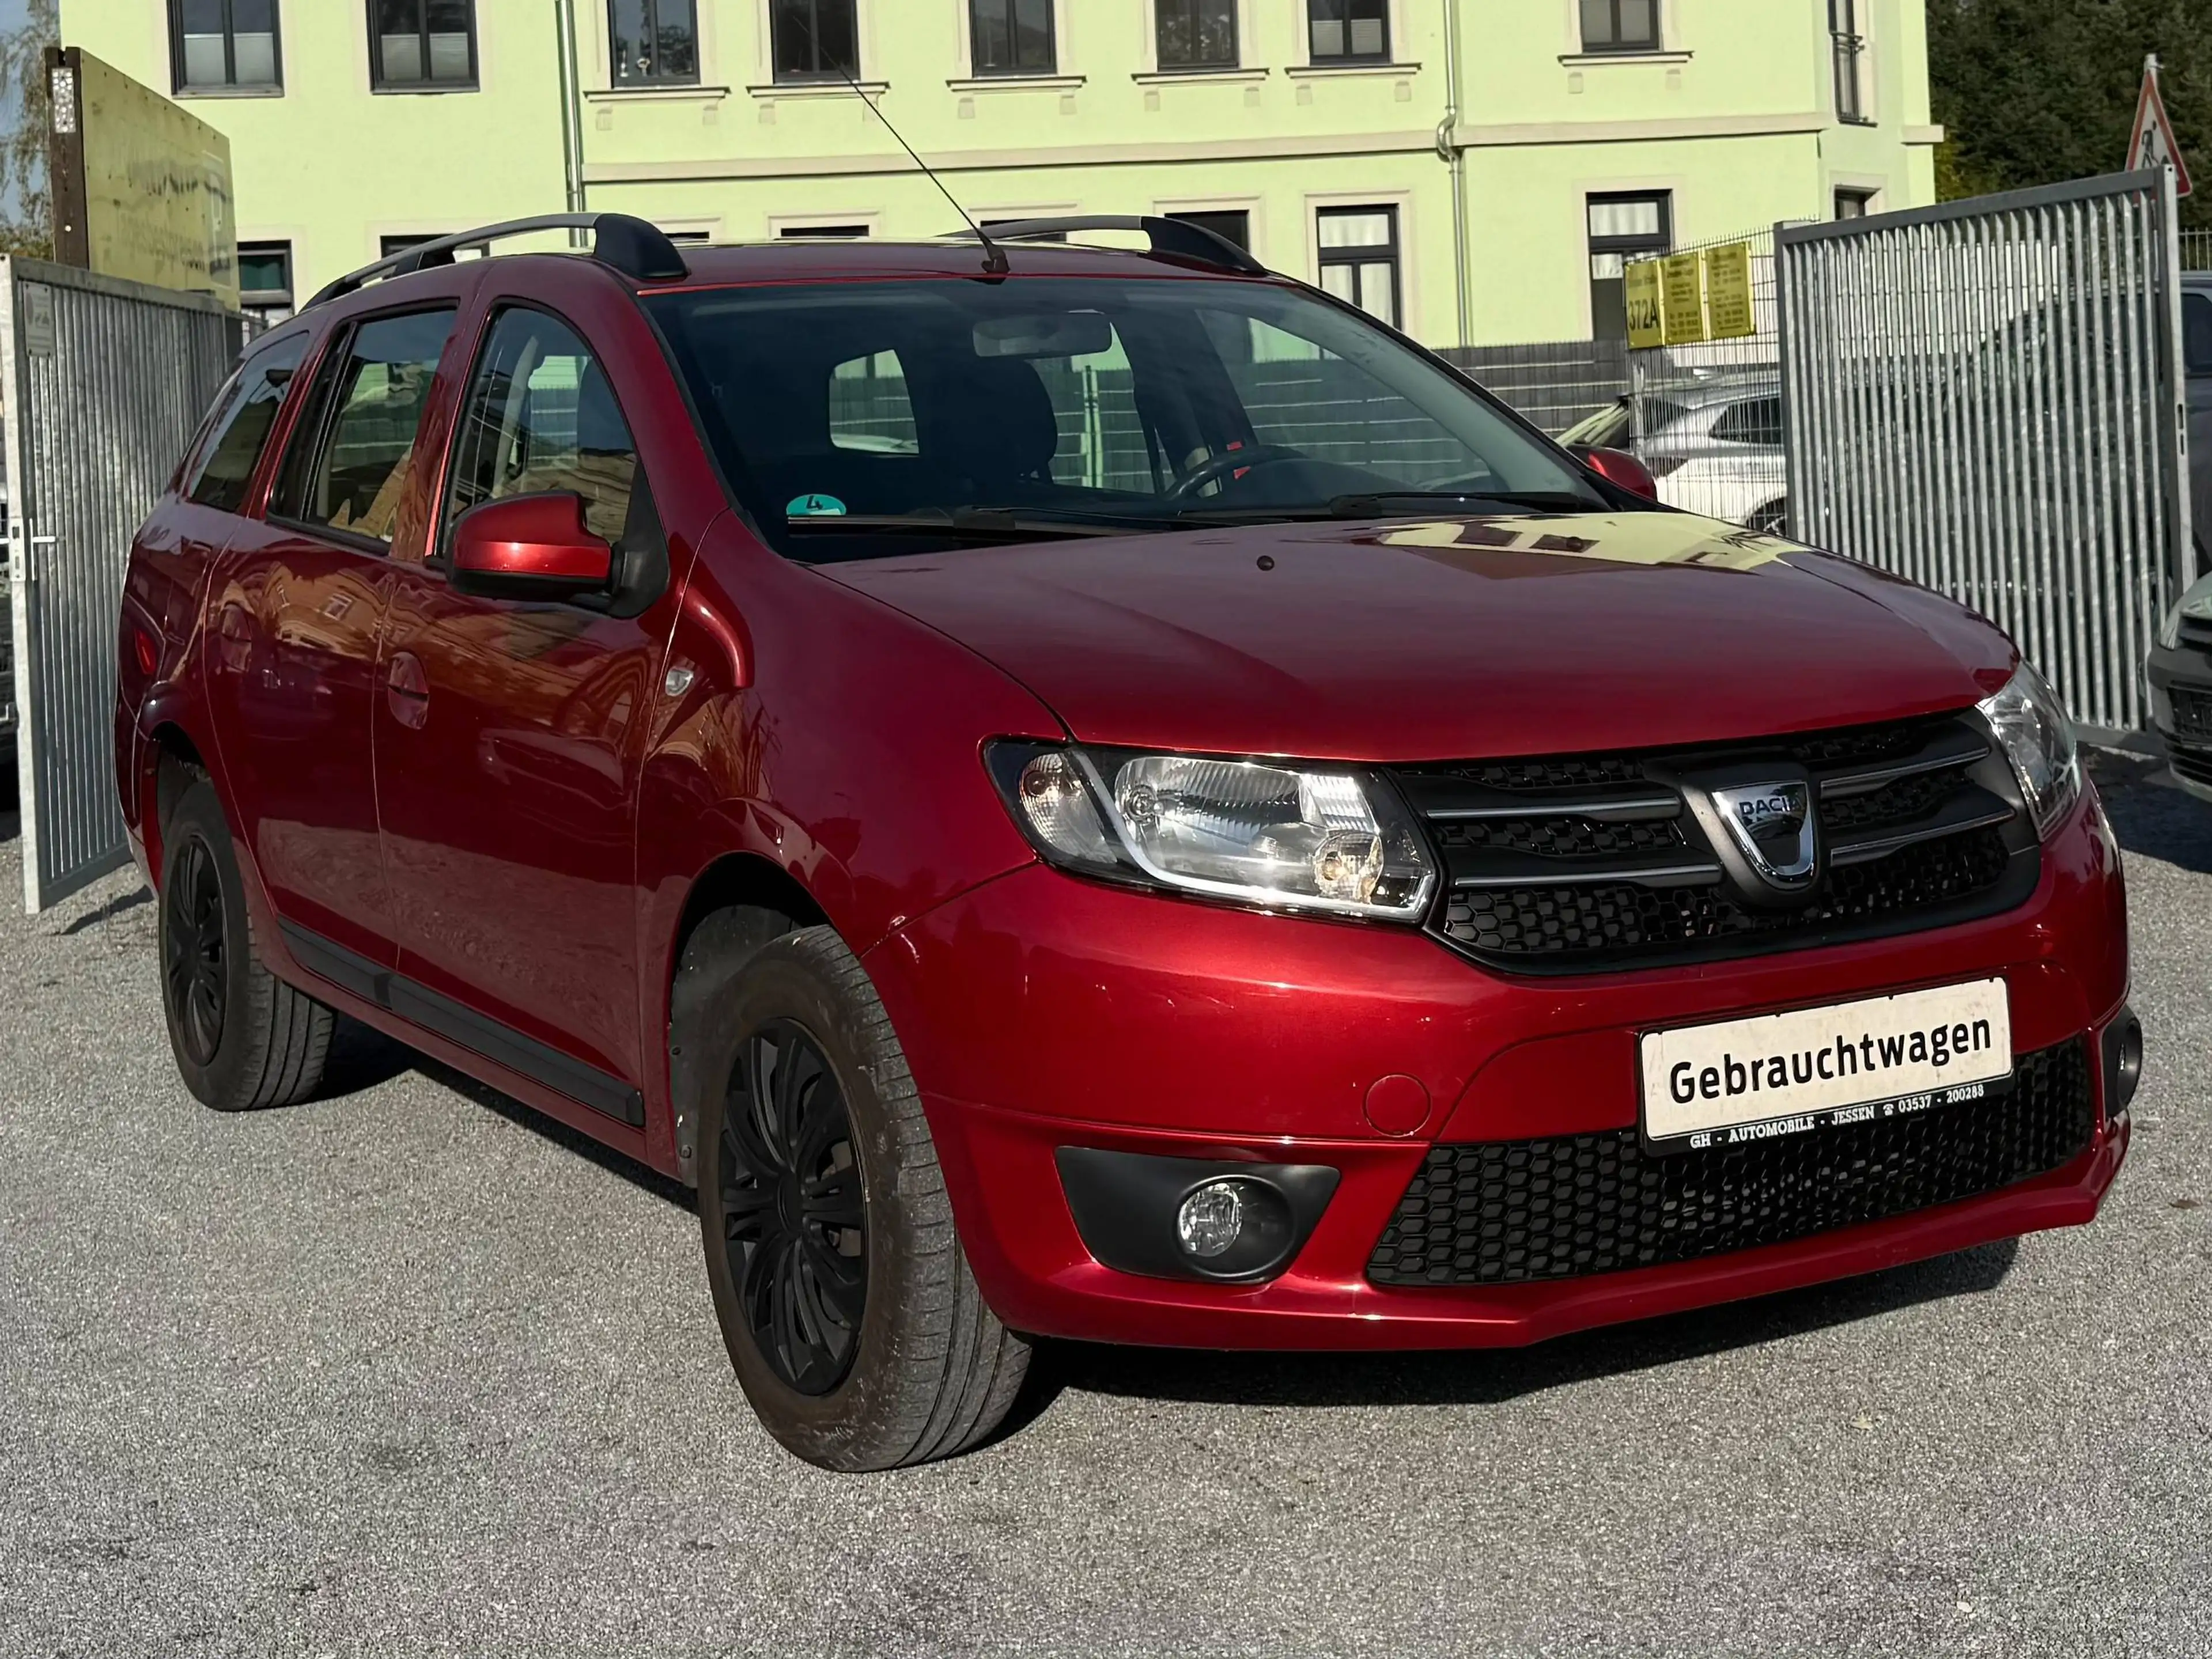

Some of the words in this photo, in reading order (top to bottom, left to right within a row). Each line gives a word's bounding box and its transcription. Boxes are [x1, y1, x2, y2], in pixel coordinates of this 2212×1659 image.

[1629, 297, 1659, 332] 372A
[806, 495, 823, 510] 4
[1670, 1017, 1991, 1104] Gebrauchtwagen
[1689, 1133, 1711, 1149] GH
[1729, 1116, 1815, 1143] AUTOMOBILE
[1832, 1105, 1875, 1126] JESSEN
[1899, 1094, 1931, 1113] 03537
[1946, 1084, 1984, 1103] 200288
